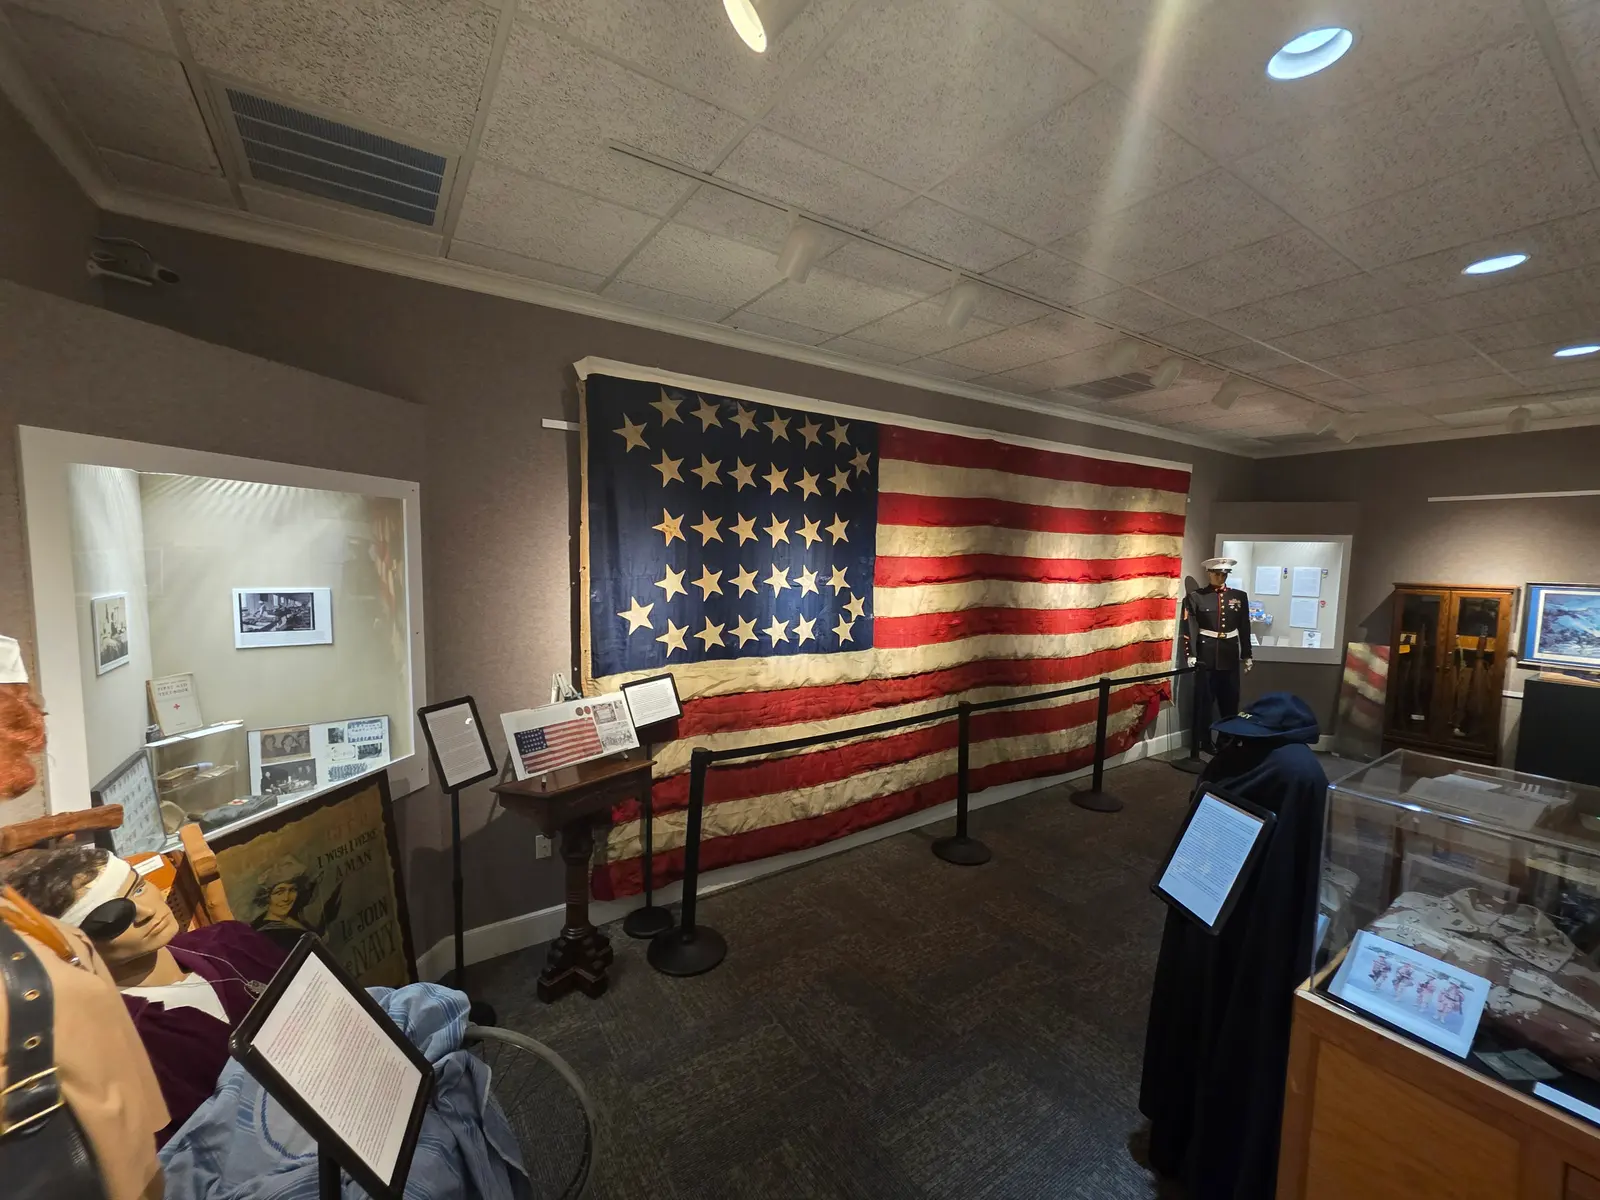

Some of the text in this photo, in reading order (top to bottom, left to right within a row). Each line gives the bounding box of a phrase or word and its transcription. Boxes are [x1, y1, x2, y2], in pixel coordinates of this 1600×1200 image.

[317, 826, 378, 870] I WISH I WERE
[335, 849, 373, 884] A MAN
[356, 896, 388, 933] JOIN
[350, 920, 396, 979] NAVY
